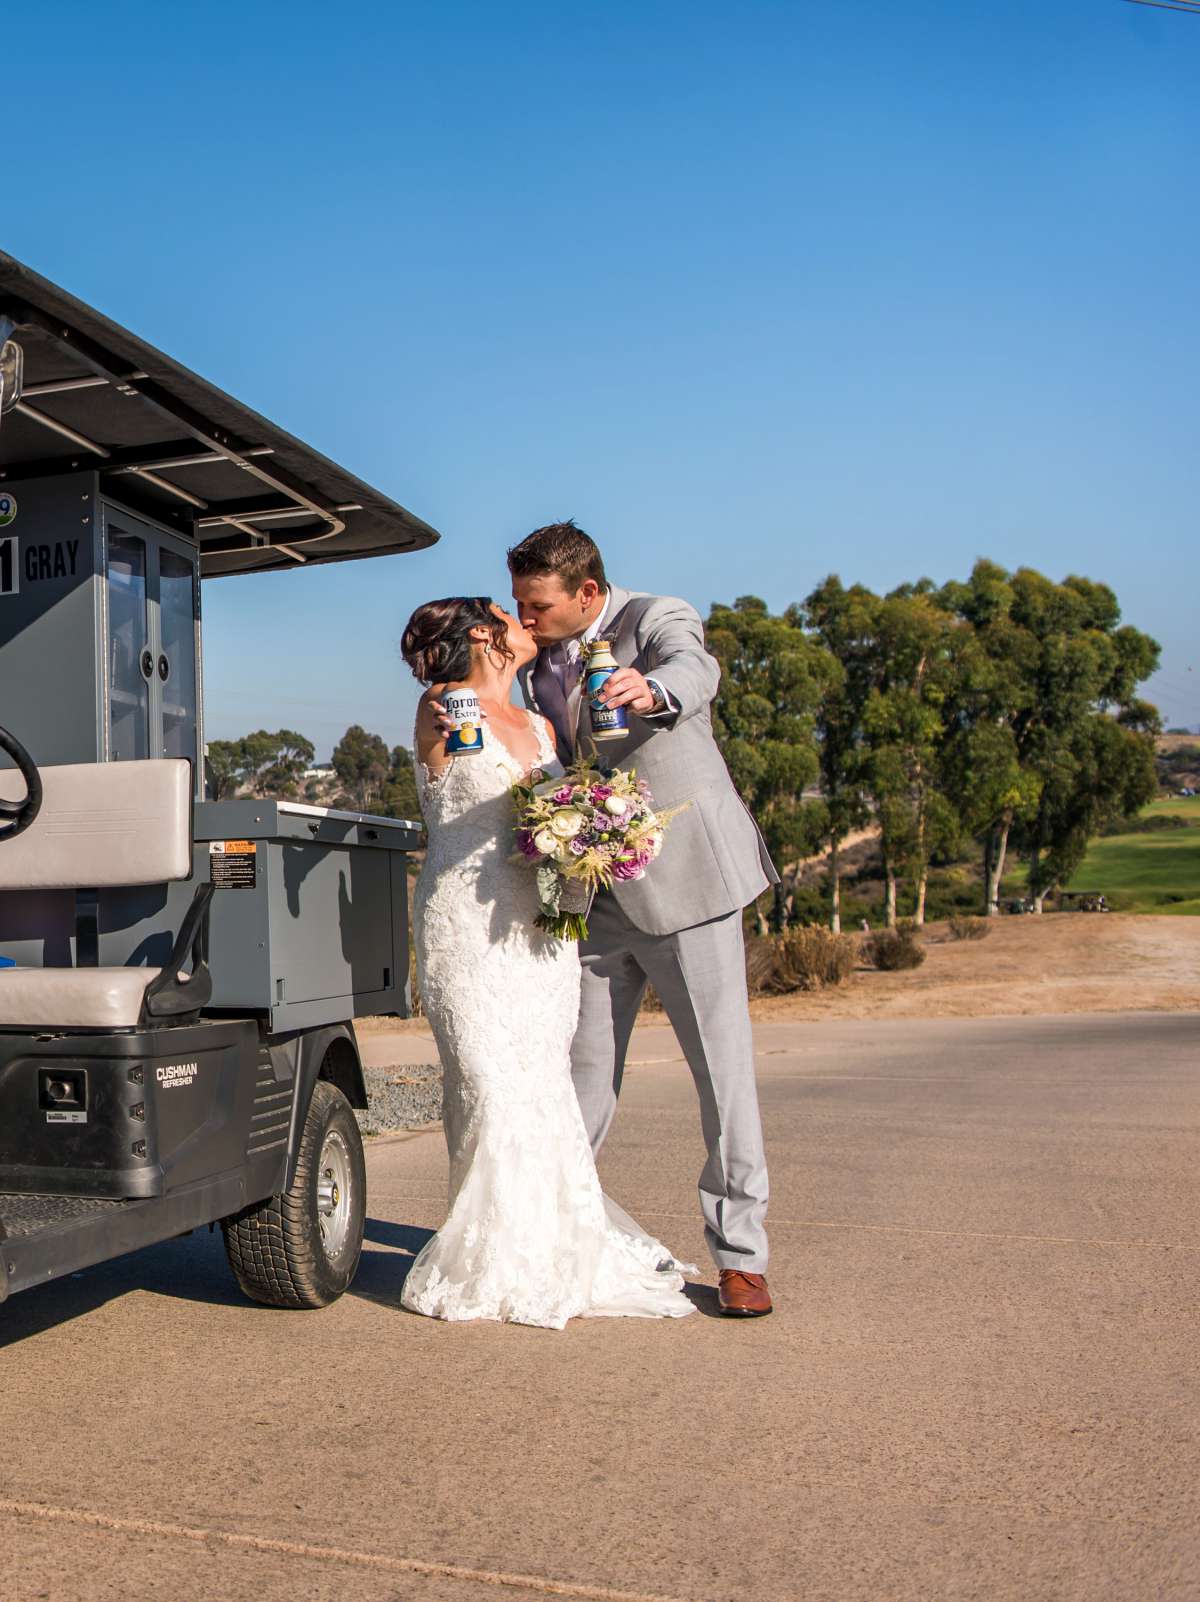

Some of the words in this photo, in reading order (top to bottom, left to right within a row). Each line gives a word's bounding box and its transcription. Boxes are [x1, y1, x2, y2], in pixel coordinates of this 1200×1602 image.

[24, 540, 79, 582] GRAY
[445, 697, 481, 714] Coron
[454, 710, 477, 719] Extra
[156, 1062, 198, 1081] CUSHMAN
[162, 1076, 193, 1089] REFRESHER
